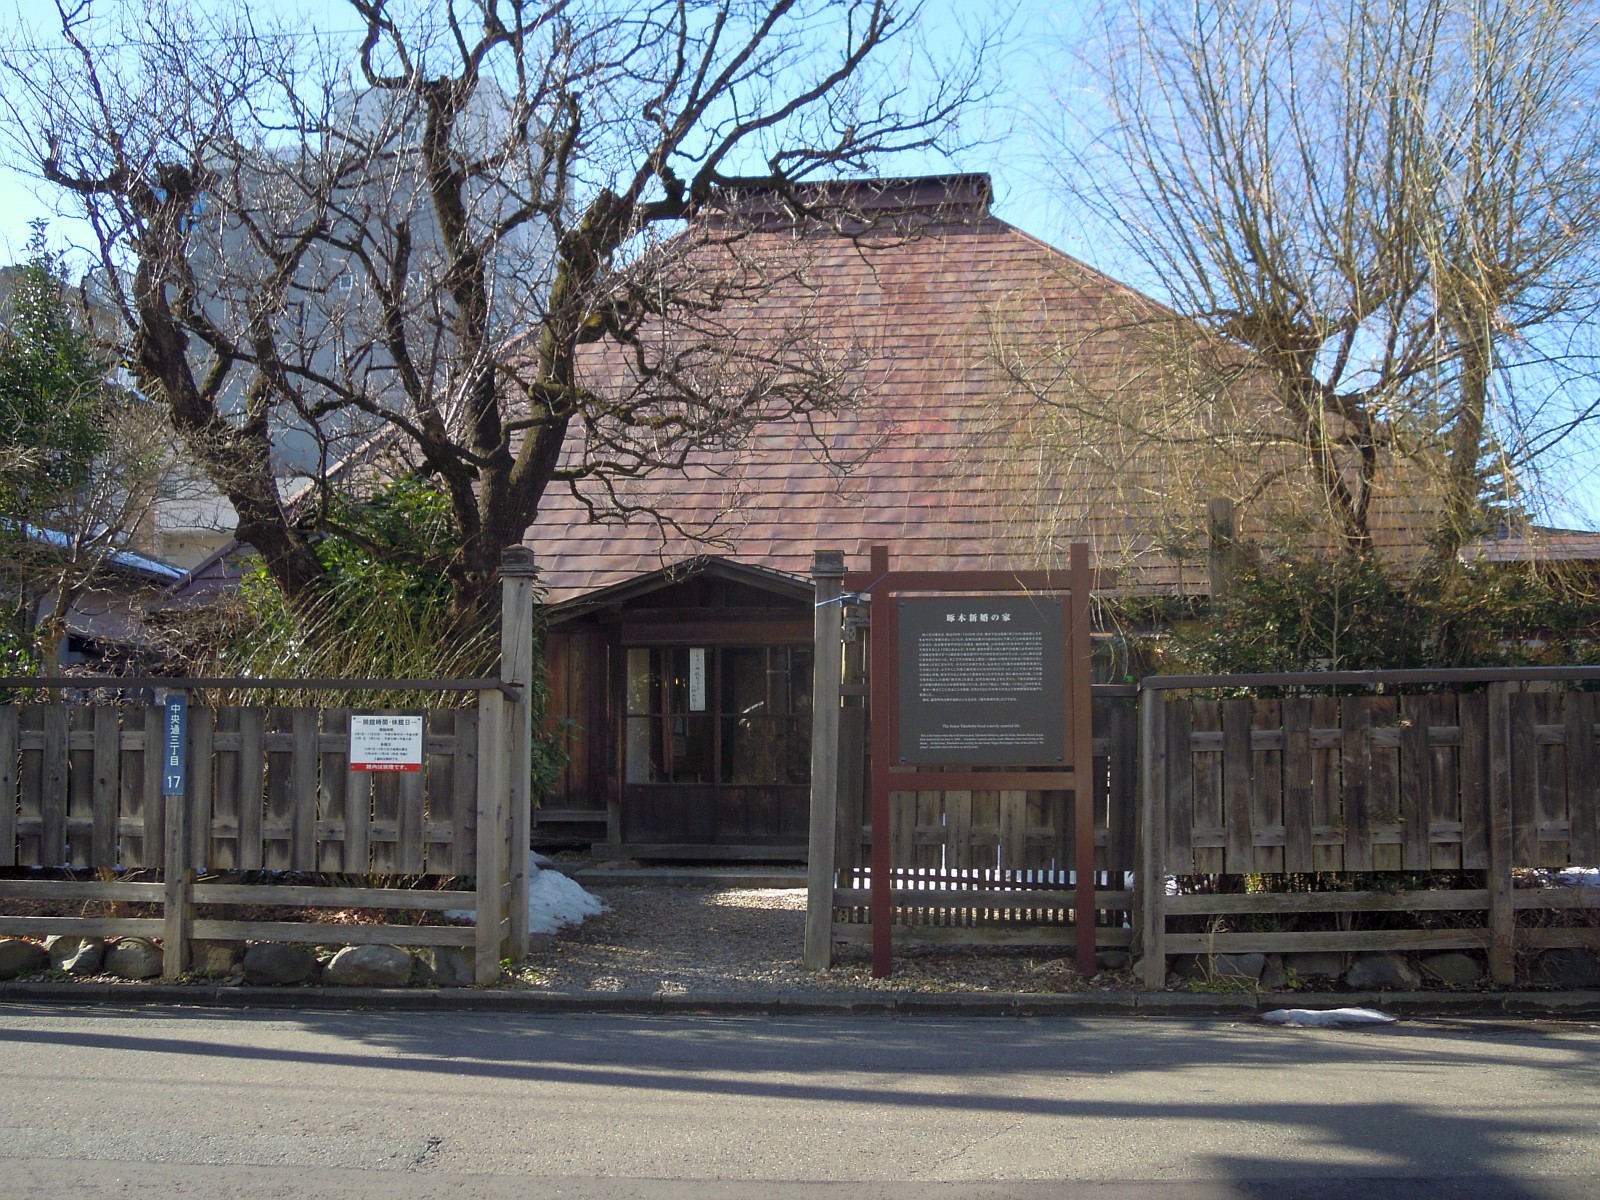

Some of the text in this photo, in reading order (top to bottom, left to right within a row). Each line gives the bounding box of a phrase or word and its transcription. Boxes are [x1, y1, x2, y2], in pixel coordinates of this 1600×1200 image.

[946, 612, 1011, 623] 啄木新婚の家
[167, 704, 181, 789] 中央通三丁目 17
